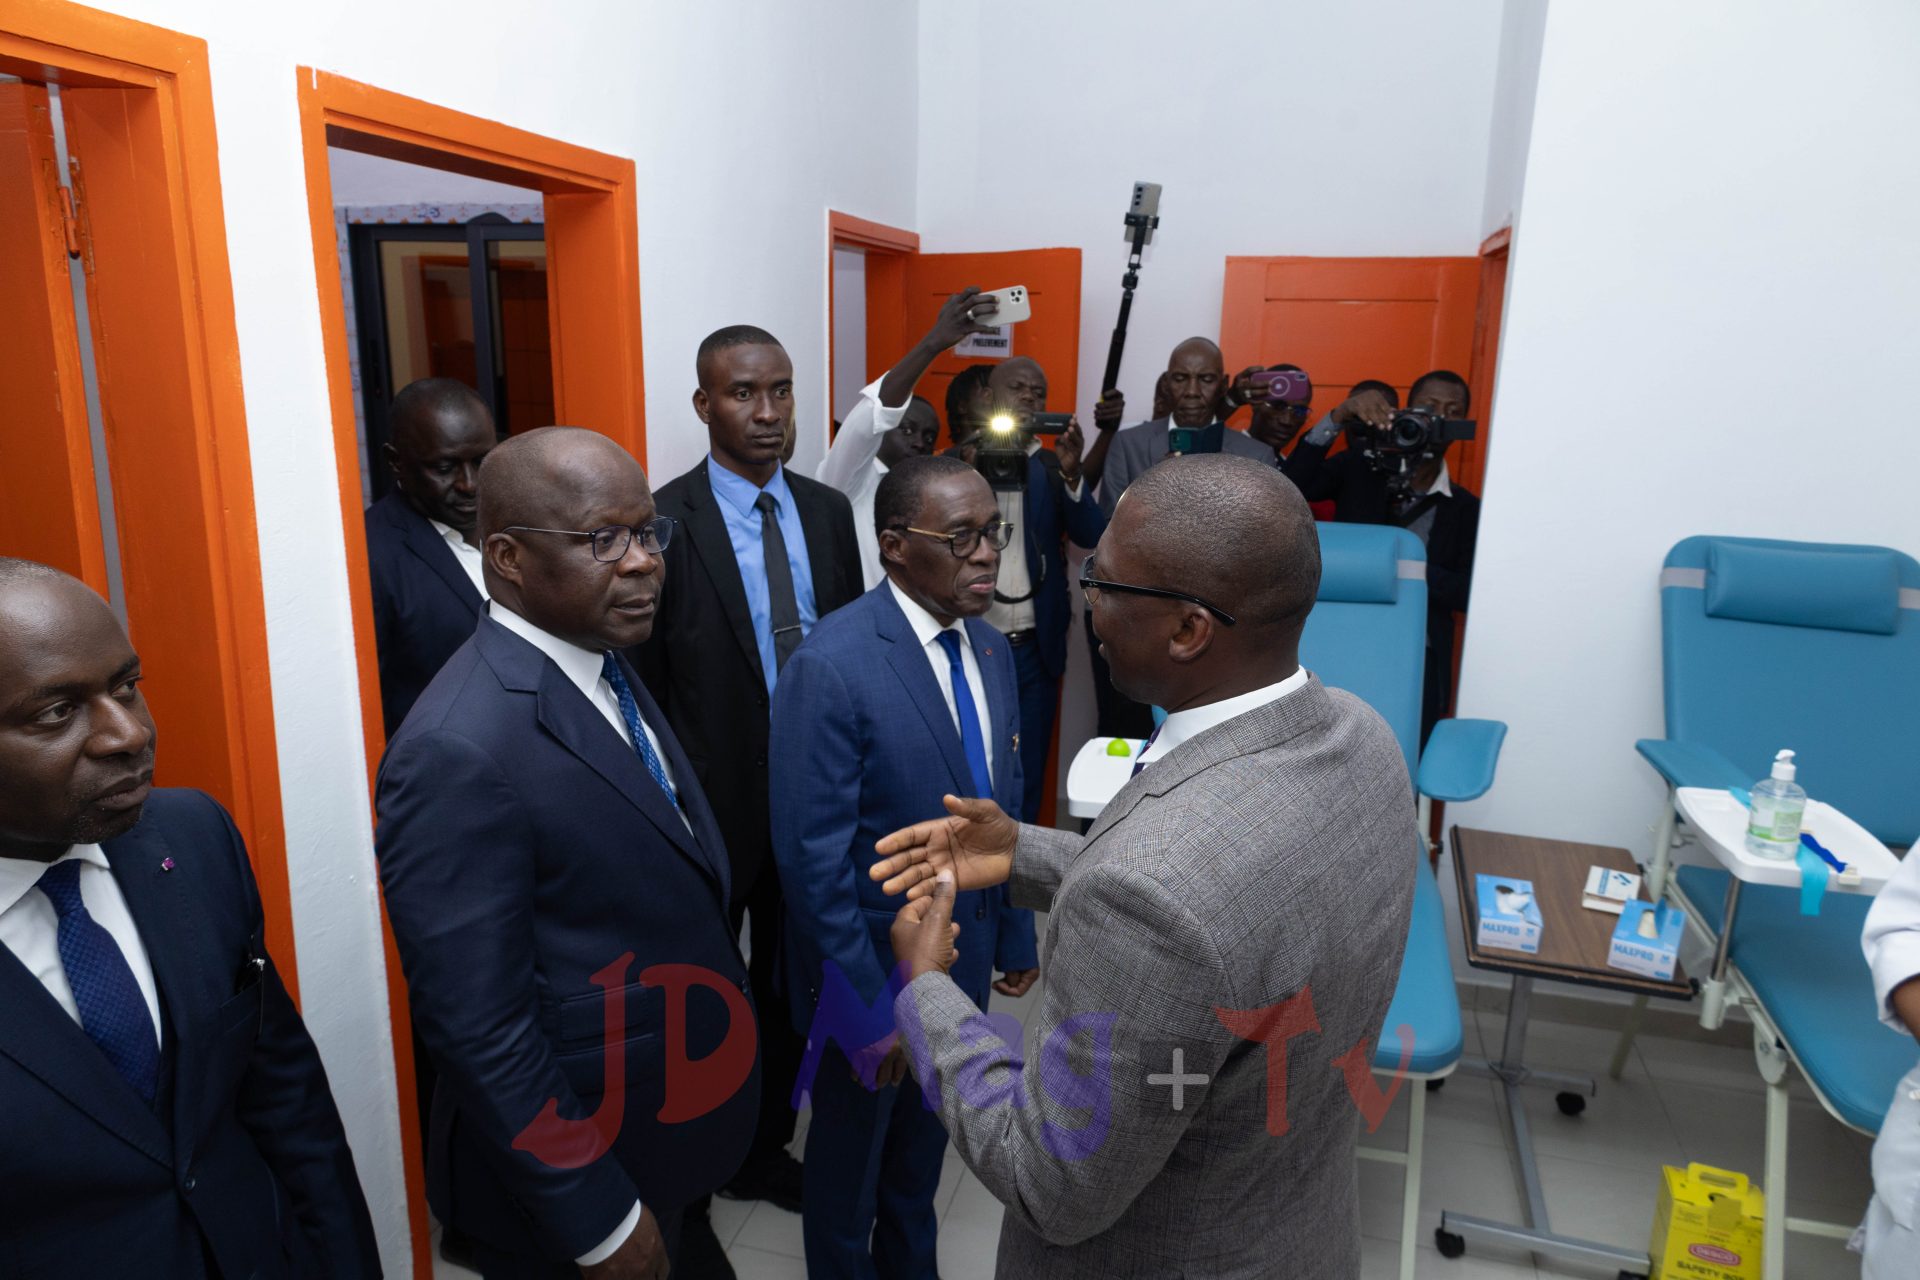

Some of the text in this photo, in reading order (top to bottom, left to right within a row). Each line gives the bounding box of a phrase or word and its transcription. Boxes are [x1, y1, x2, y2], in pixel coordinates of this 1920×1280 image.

[1482, 922, 1520, 936] MAXPRO
[1613, 943, 1654, 962] MAXPRO
[1677, 1261, 1720, 1277] SAFETY
